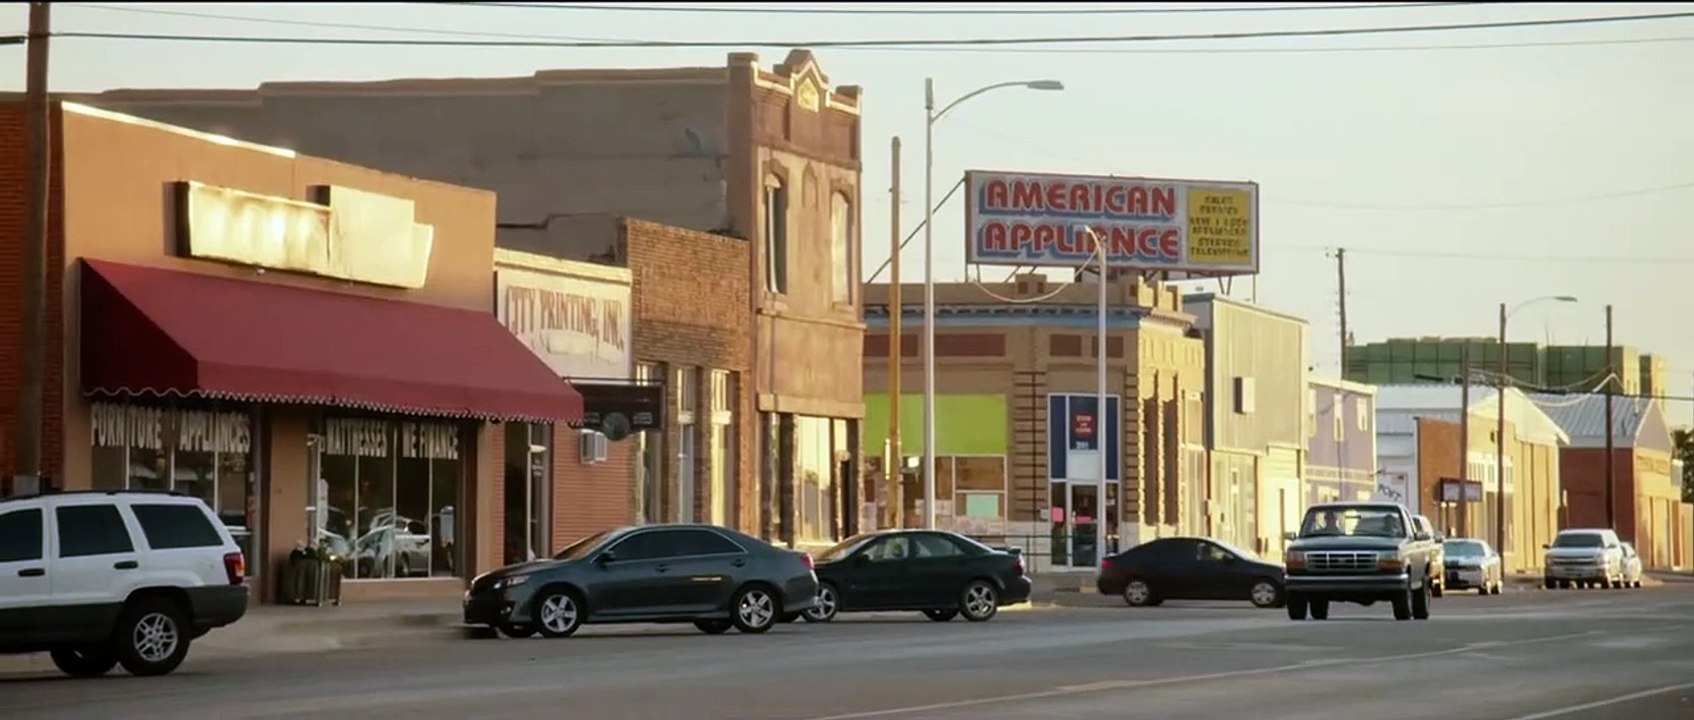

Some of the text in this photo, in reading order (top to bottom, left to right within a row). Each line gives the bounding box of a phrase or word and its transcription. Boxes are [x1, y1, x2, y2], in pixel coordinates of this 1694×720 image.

[983, 177, 1177, 217] AMERICAN
[982, 220, 1181, 258] APPLIANCE
[505, 285, 537, 335] CITY
[91, 401, 250, 453] FURNITURE APPLIANCES
